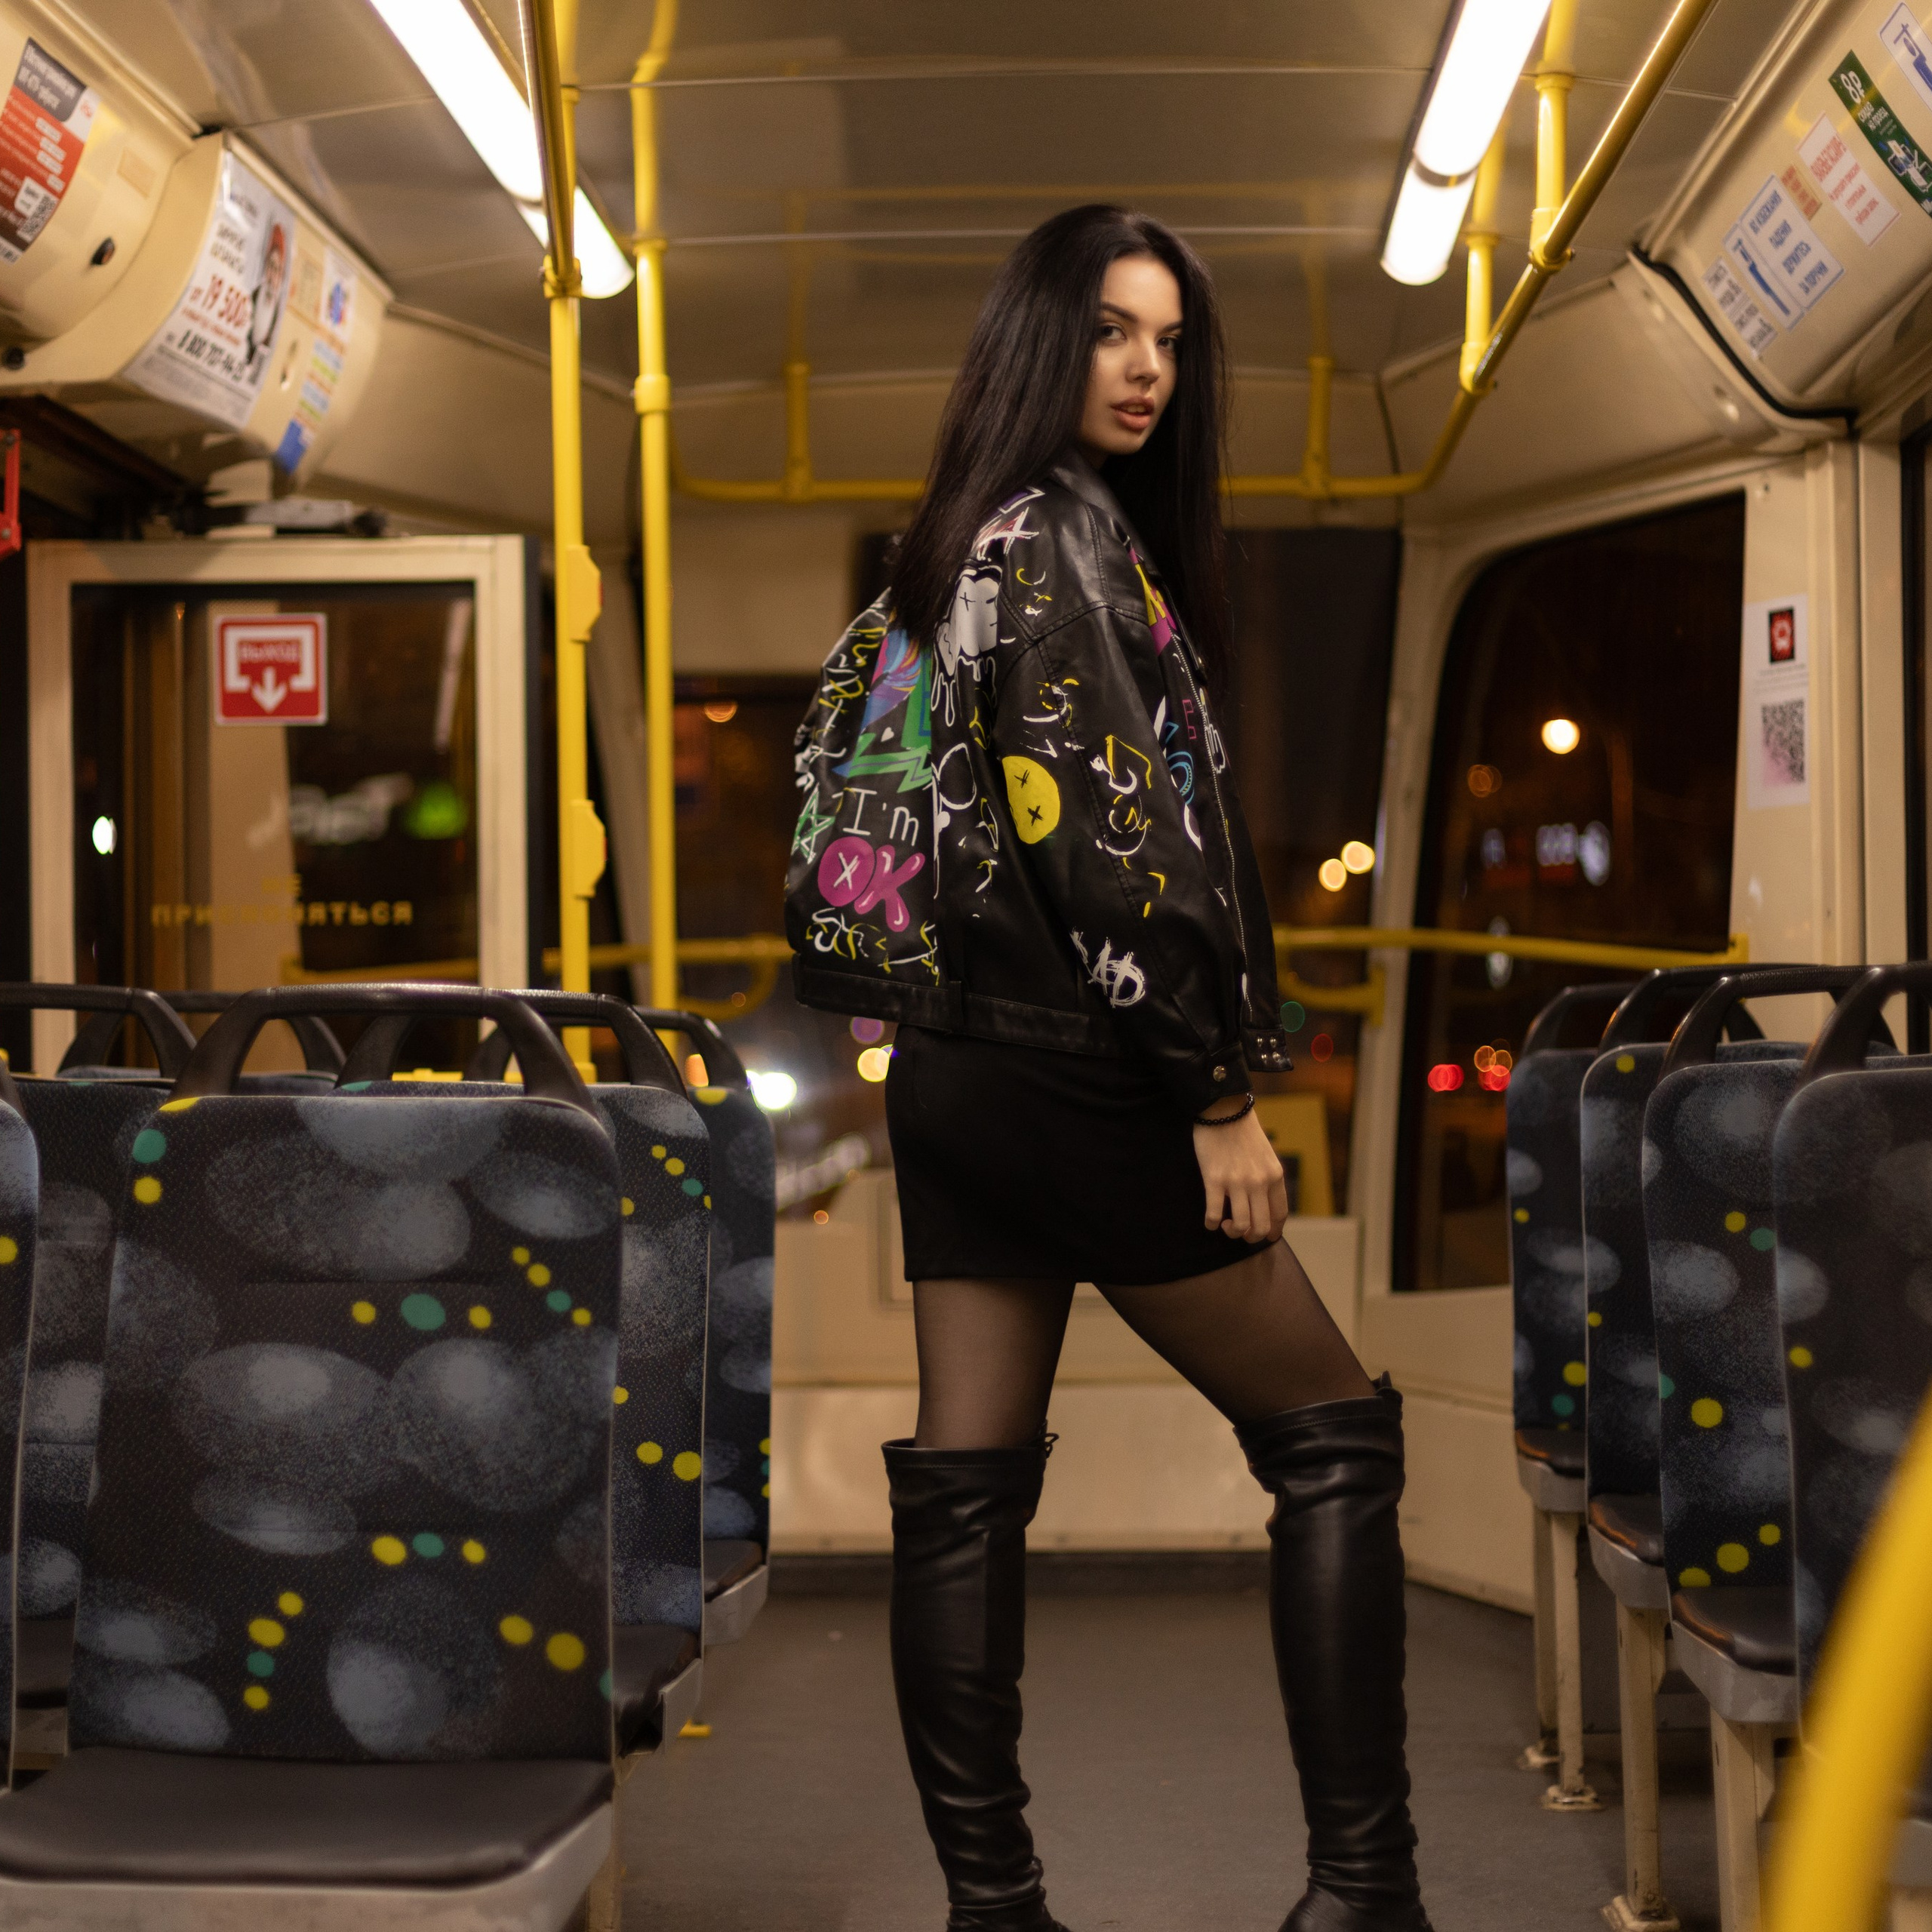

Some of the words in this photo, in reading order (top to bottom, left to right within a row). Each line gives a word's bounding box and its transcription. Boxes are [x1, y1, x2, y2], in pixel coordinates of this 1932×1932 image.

[1768, 219, 1792, 249] ПАДЕНИЯ
[1782, 241, 1811, 275] ДЕРЖИТЕСЬ
[1798, 281, 1810, 295] ЗА
[841, 787, 919, 846] I'm
[818, 836, 925, 932] OK
